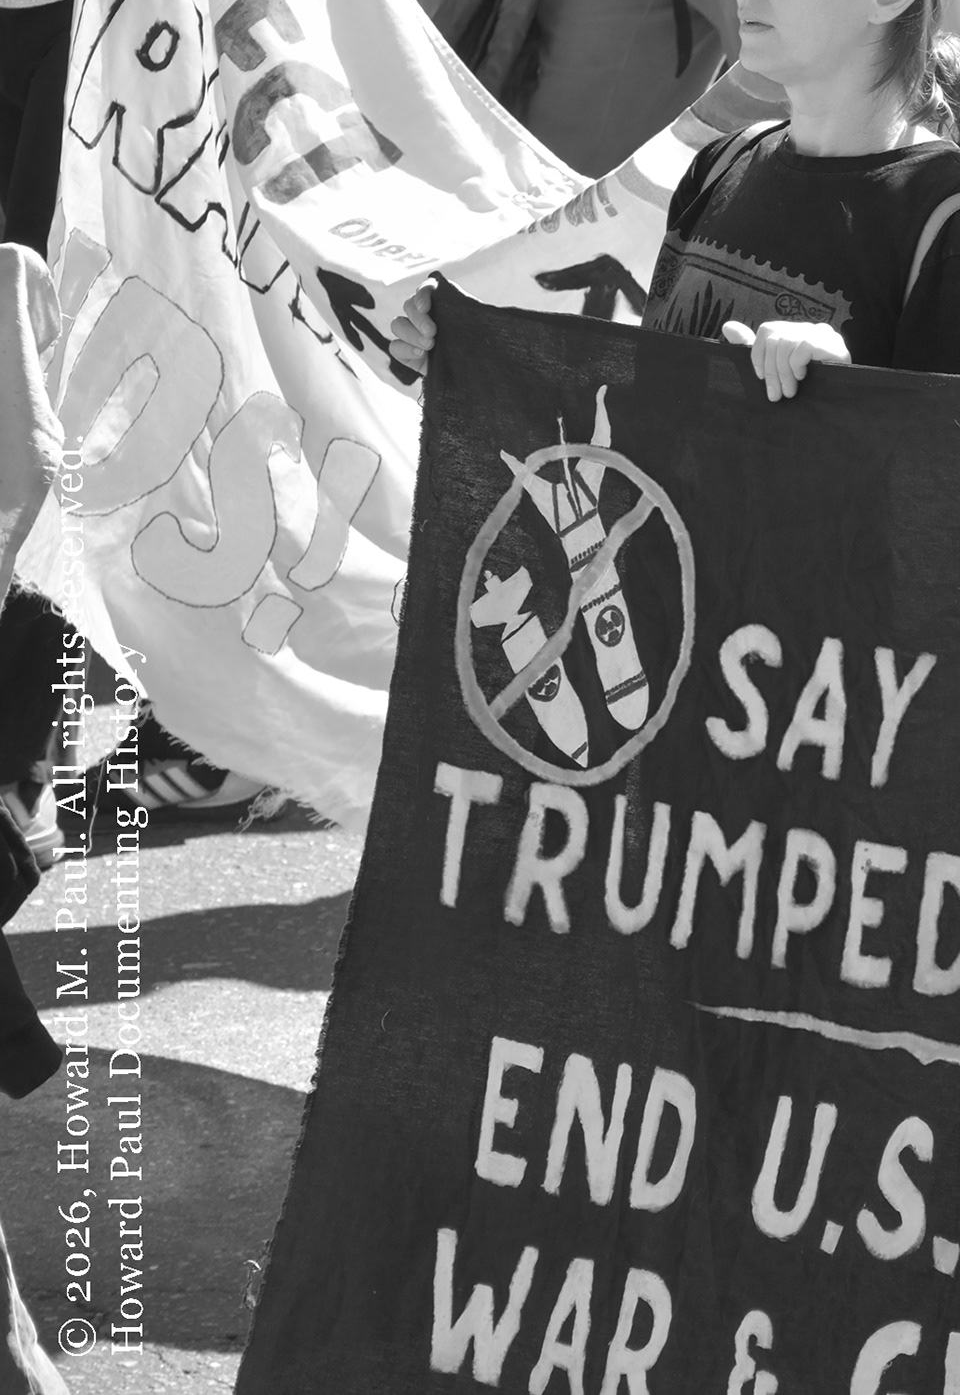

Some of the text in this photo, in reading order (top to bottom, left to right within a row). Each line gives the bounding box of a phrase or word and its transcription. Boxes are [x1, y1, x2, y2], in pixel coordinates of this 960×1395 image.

[706, 623, 936, 788] SAY
[476, 1036, 696, 1212] END
[752, 1094, 960, 1277] U.S.
[430, 1228, 672, 1395] WAR
